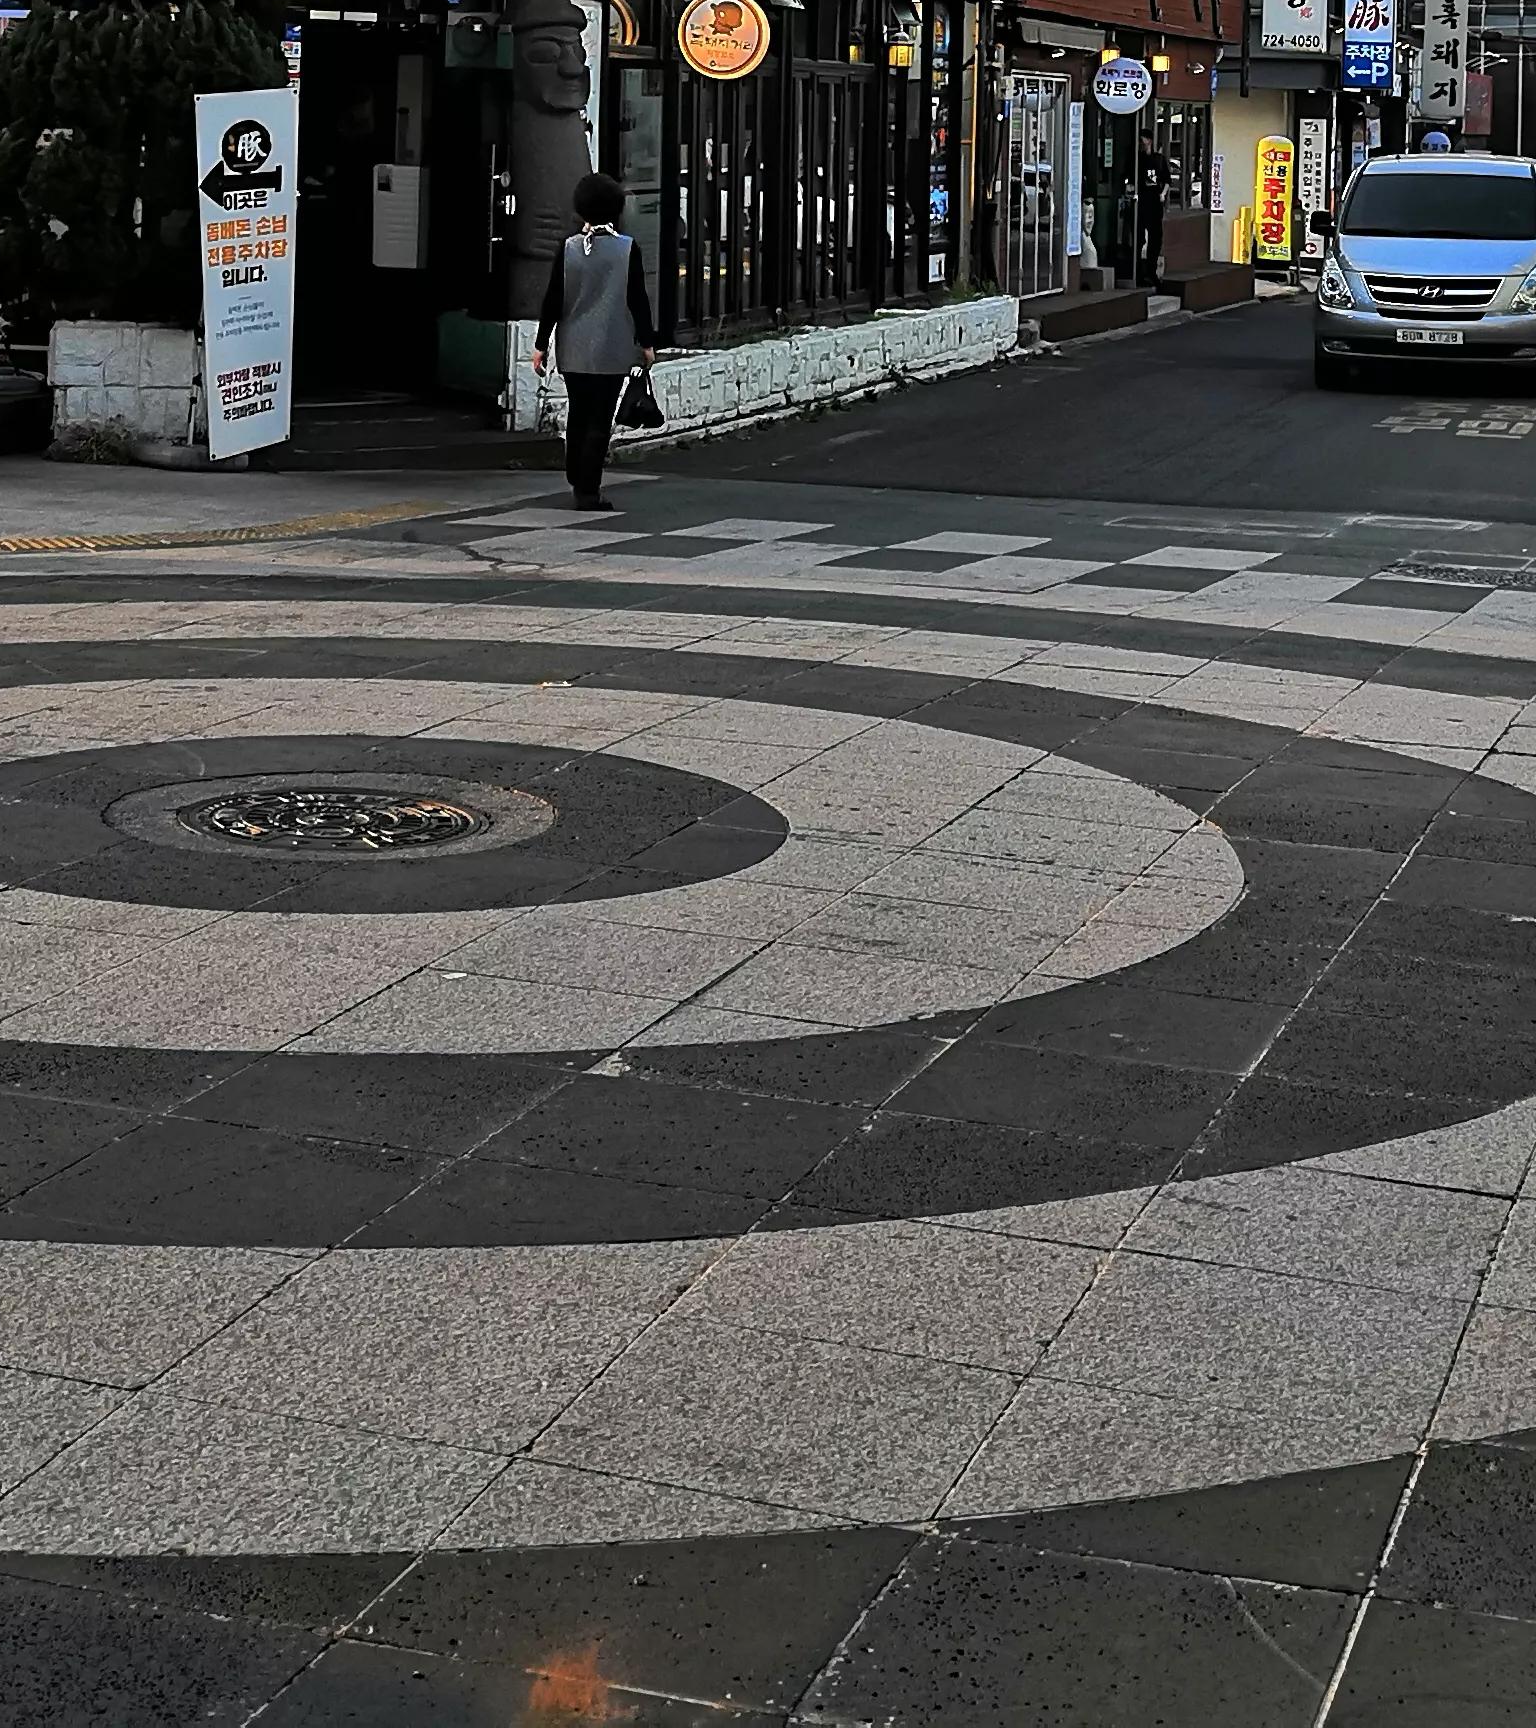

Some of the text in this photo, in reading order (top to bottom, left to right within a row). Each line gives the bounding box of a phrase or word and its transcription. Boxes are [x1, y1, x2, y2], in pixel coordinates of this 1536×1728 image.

[1263, 34, 1320, 48] 724-4050
[1345, 44, 1392, 61] 주차장
[1371, 62, 1389, 84] P
[223, 190, 268, 211] 이곳은
[1261, 177, 1286, 245] 주차장
[255, 214, 288, 236] 손님
[207, 239, 288, 268] 전용주차장
[221, 265, 268, 288] 입니다.
